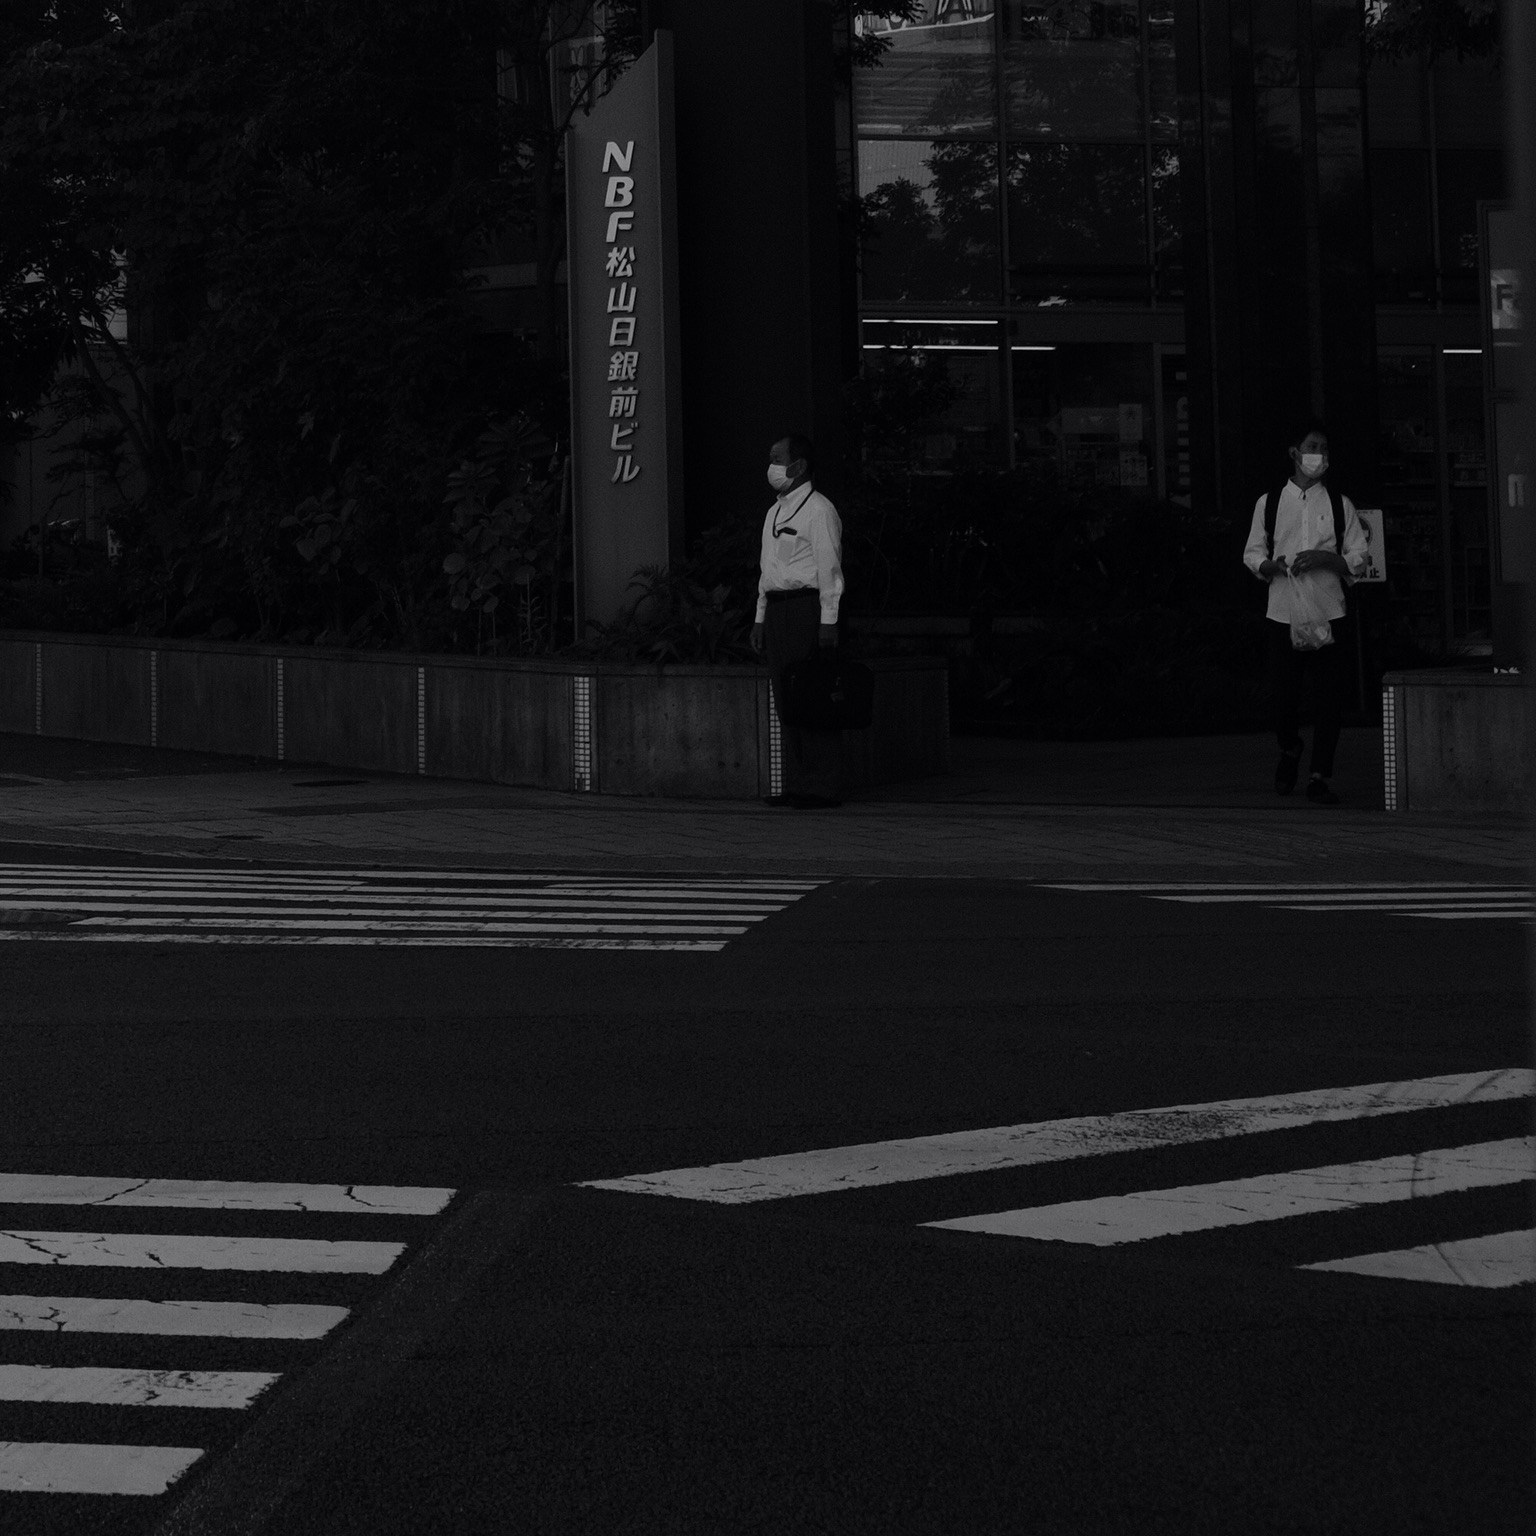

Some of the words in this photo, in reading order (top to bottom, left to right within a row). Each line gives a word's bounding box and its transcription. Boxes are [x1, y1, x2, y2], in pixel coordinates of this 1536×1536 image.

[601, 139, 641, 484] NBF松山日銀前ビル
